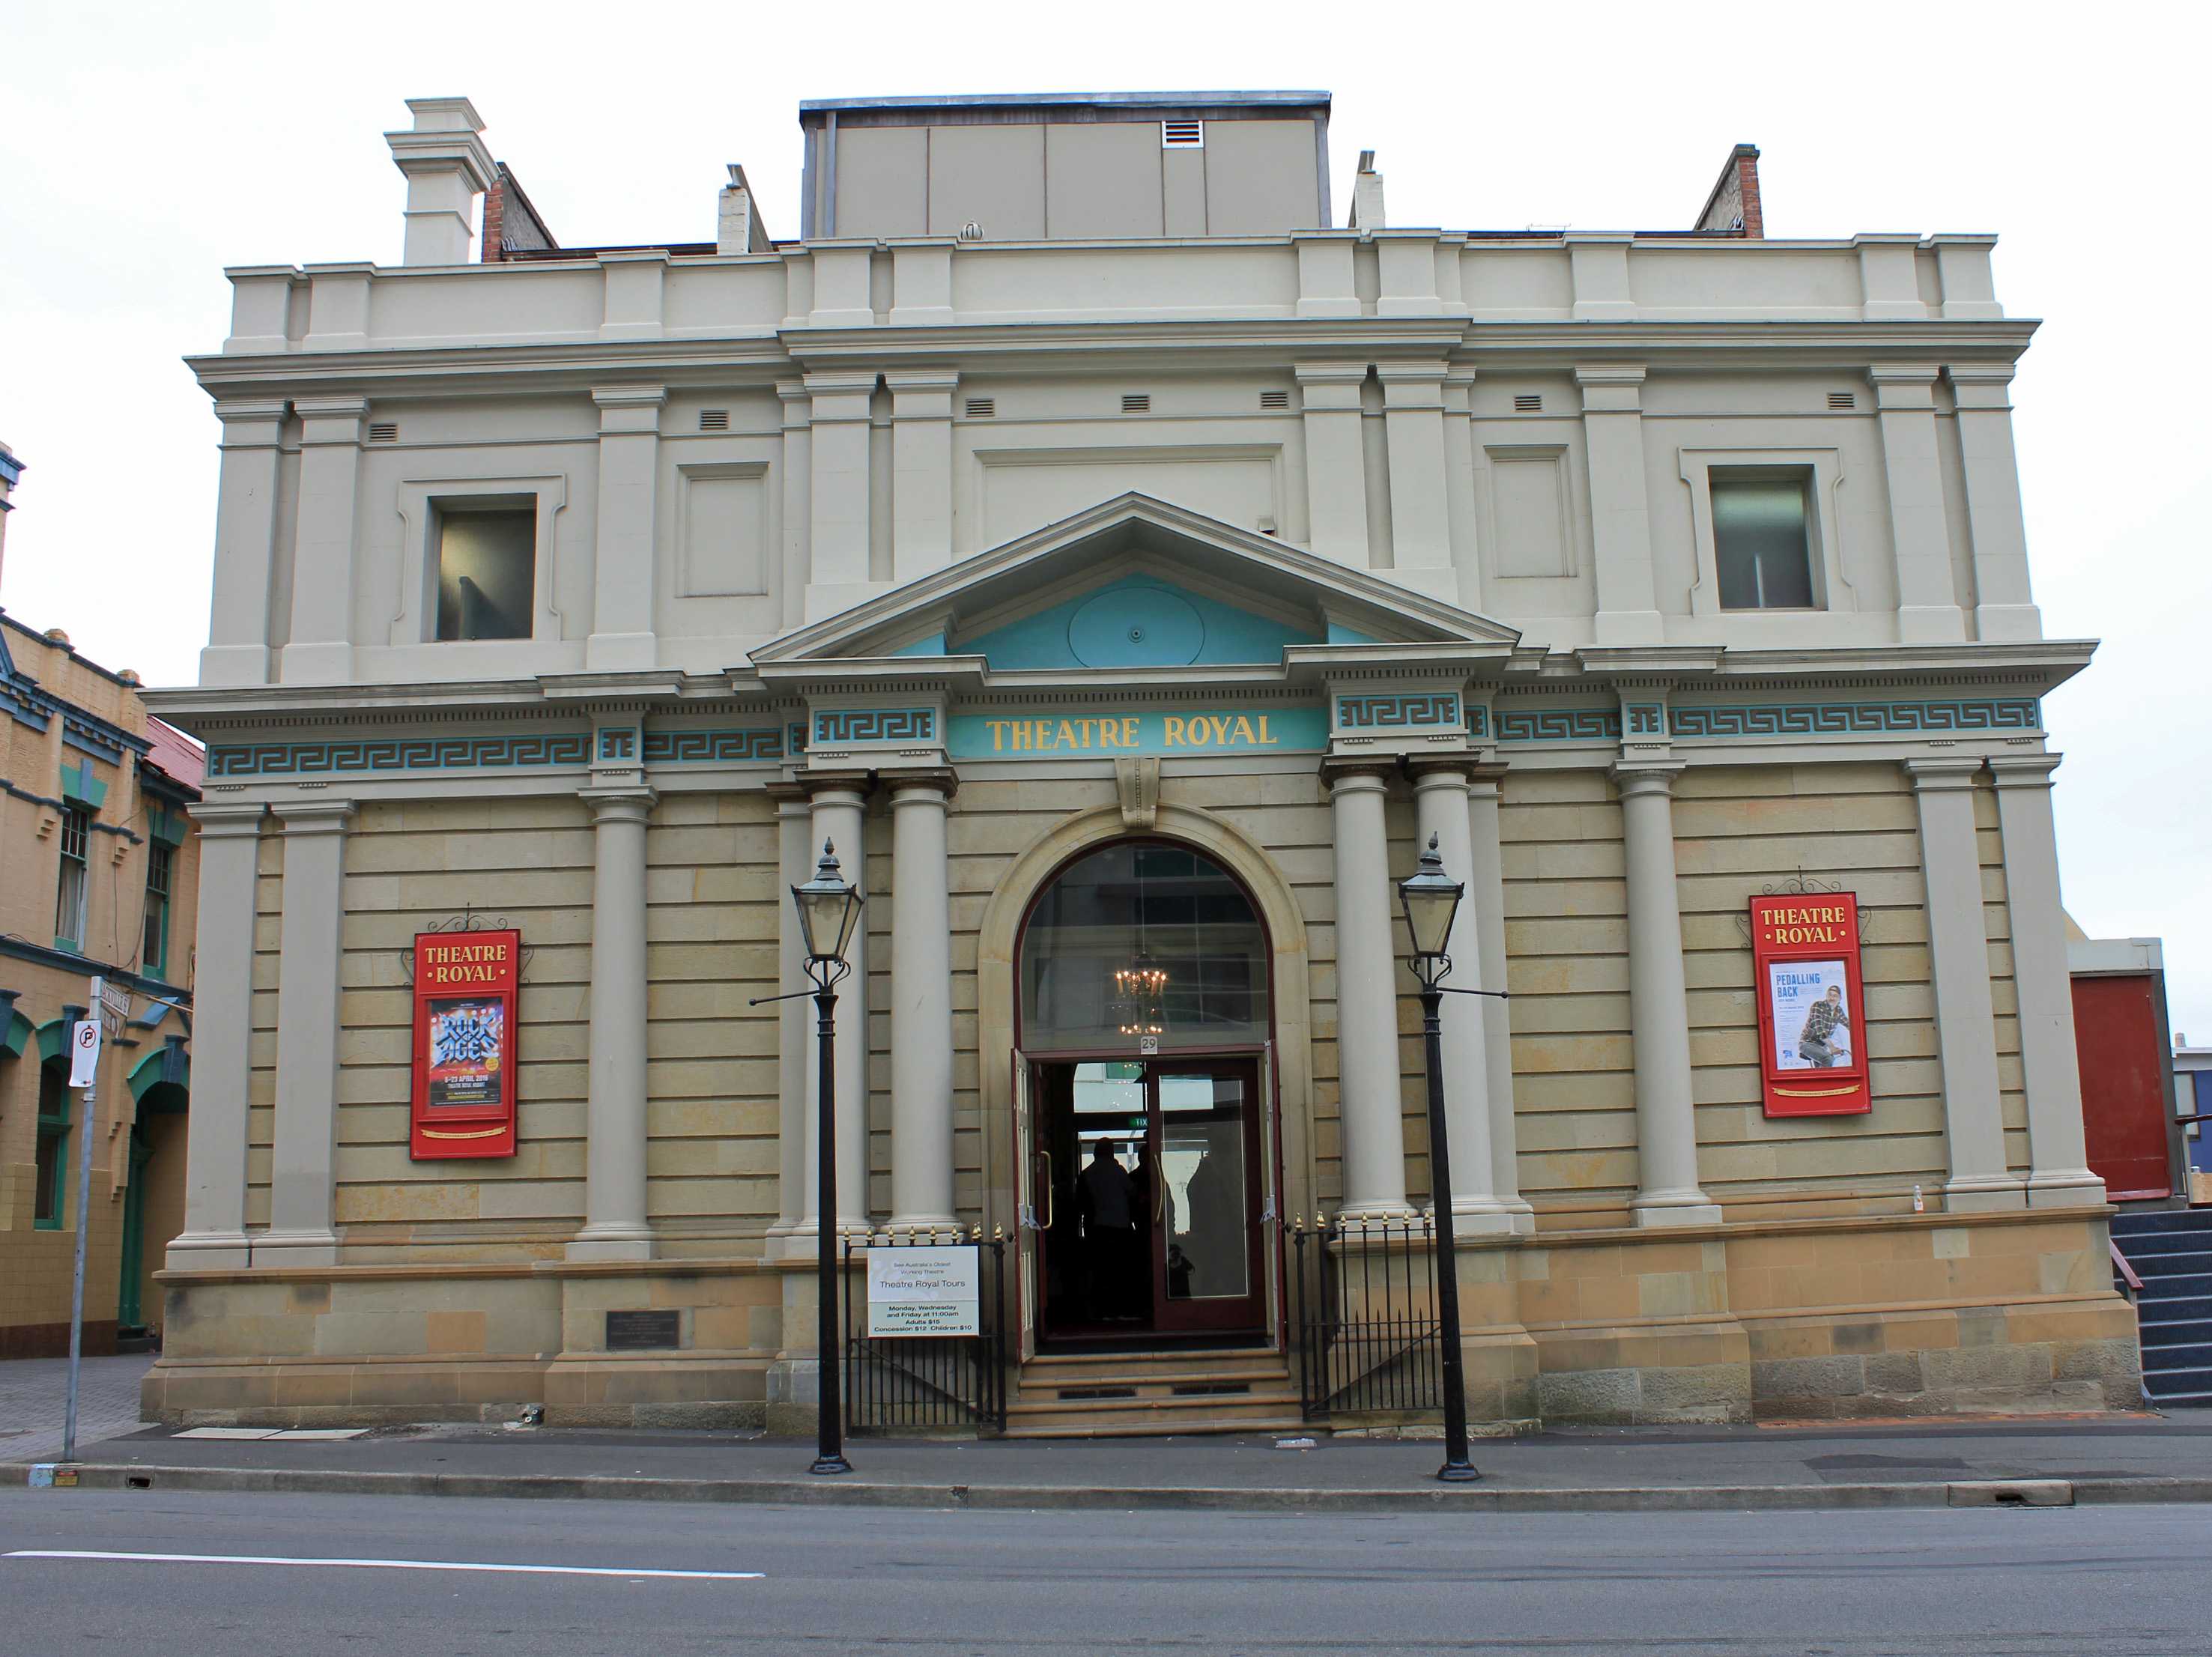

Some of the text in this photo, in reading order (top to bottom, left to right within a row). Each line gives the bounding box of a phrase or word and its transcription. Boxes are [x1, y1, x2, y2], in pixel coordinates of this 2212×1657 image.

[985, 715, 1278, 751] THEATRE ROYAL
[1760, 906, 1845, 926] THEATRE
[1775, 927, 1837, 945] ROYAL
[425, 944, 506, 964] THEATRE
[435, 964, 497, 983] ROYAL
[1775, 973, 1820, 986] PEDALLING
[1777, 986, 1799, 998] BACK
[437, 1011, 498, 1040] ROCK
[432, 1037, 499, 1067] AGES
[1142, 1038, 1157, 1049] 29
[879, 1279, 966, 1289] Theatre Royal Tours
